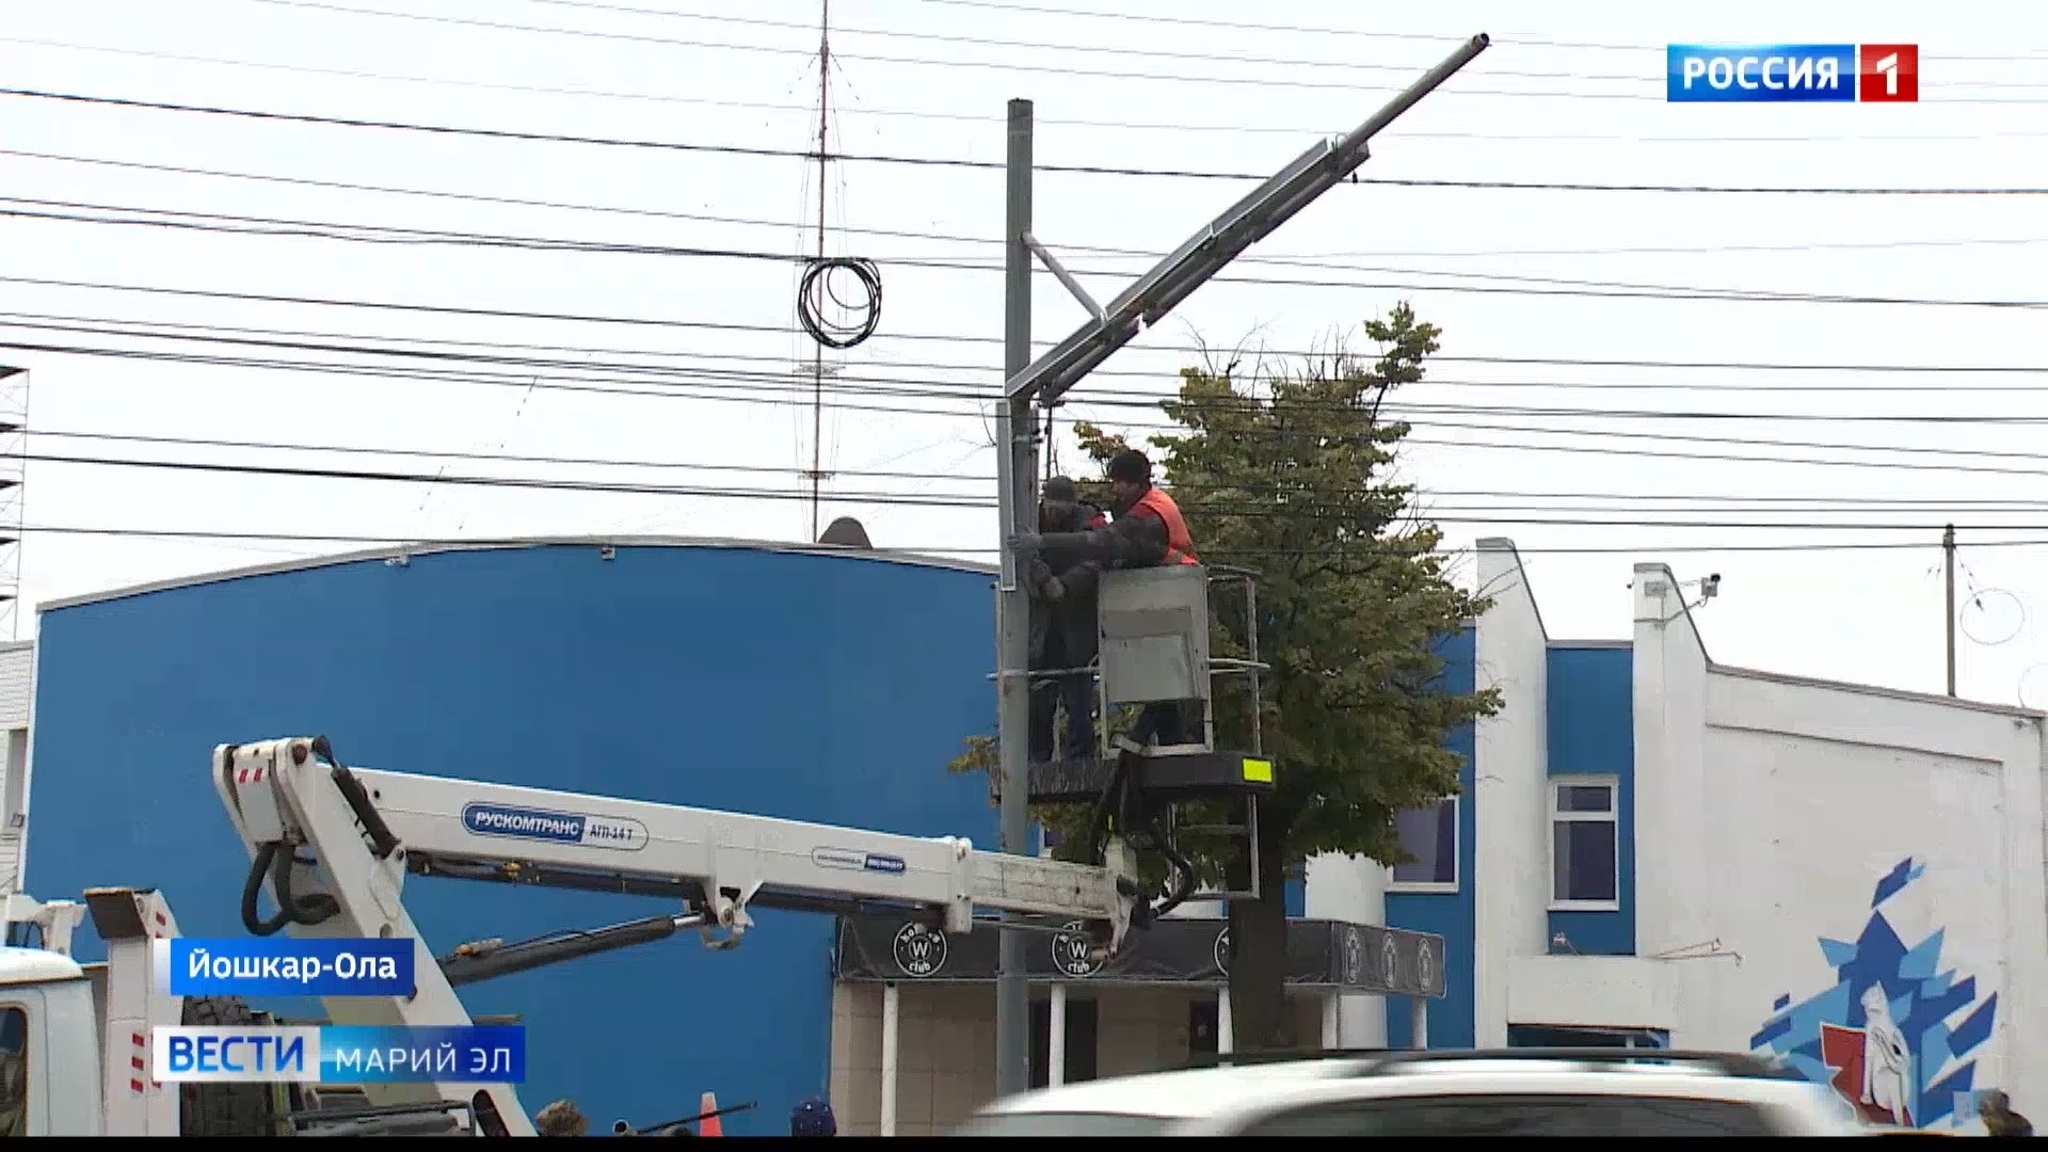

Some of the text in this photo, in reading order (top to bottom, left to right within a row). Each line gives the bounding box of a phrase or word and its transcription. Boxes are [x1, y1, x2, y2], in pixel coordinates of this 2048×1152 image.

[475, 811, 580, 836] РУСКОМТРАНС
[912, 941, 929, 958] W
[1070, 941, 1087, 958] W
